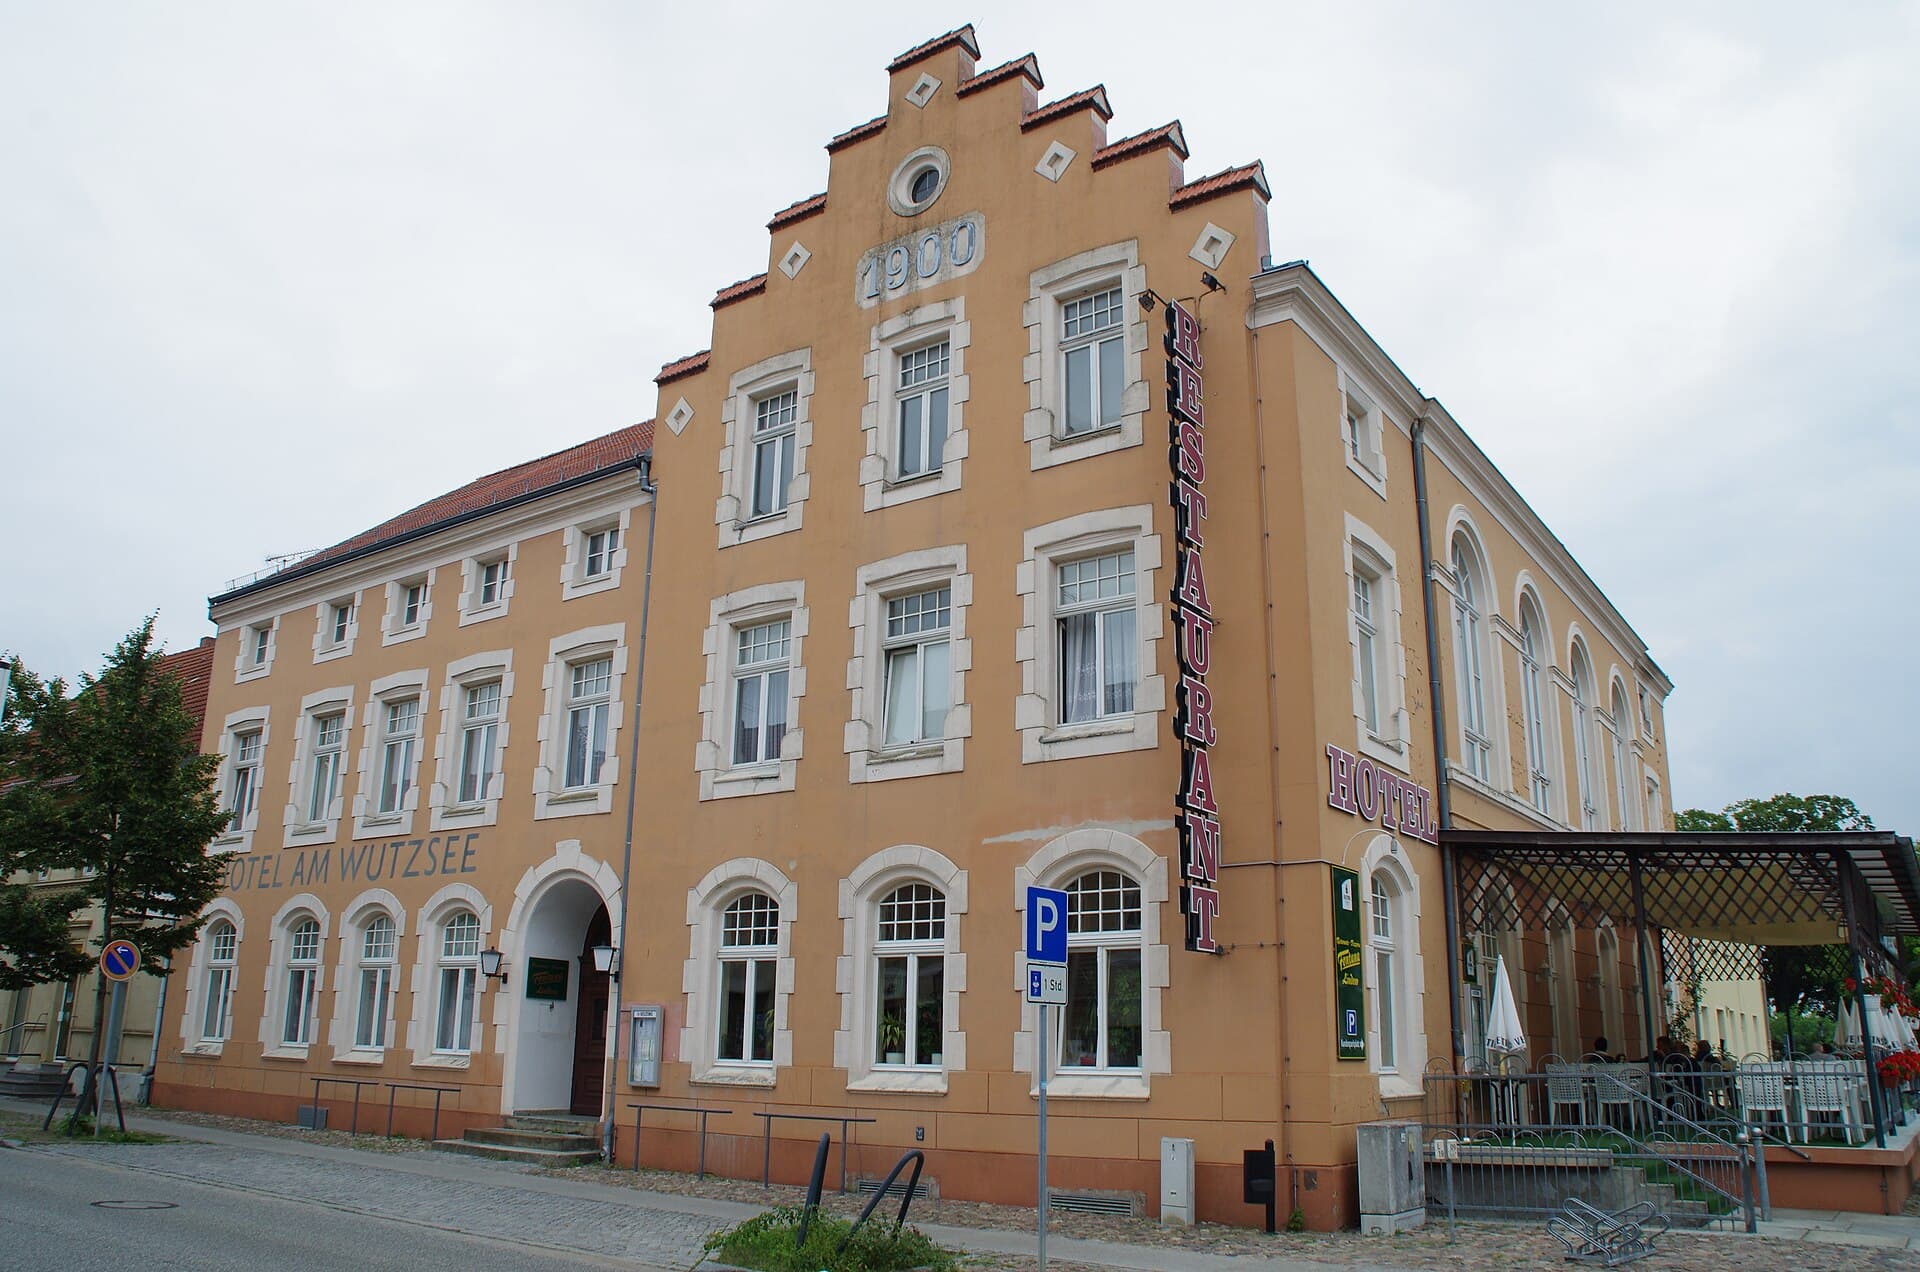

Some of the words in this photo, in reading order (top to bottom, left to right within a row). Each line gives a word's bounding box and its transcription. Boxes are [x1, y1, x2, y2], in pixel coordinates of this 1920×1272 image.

[862, 221, 976, 299] 1900
[1171, 298, 1220, 953] RESTAURANT
[1326, 743, 1438, 845] HOTEL
[290, 849, 331, 888] AM
[339, 832, 480, 882] WUTZSEE
[1036, 896, 1058, 952] P
[1044, 978, 1048, 991] 1
[1050, 979, 1064, 991] Std.
[1348, 1013, 1355, 1033] P
